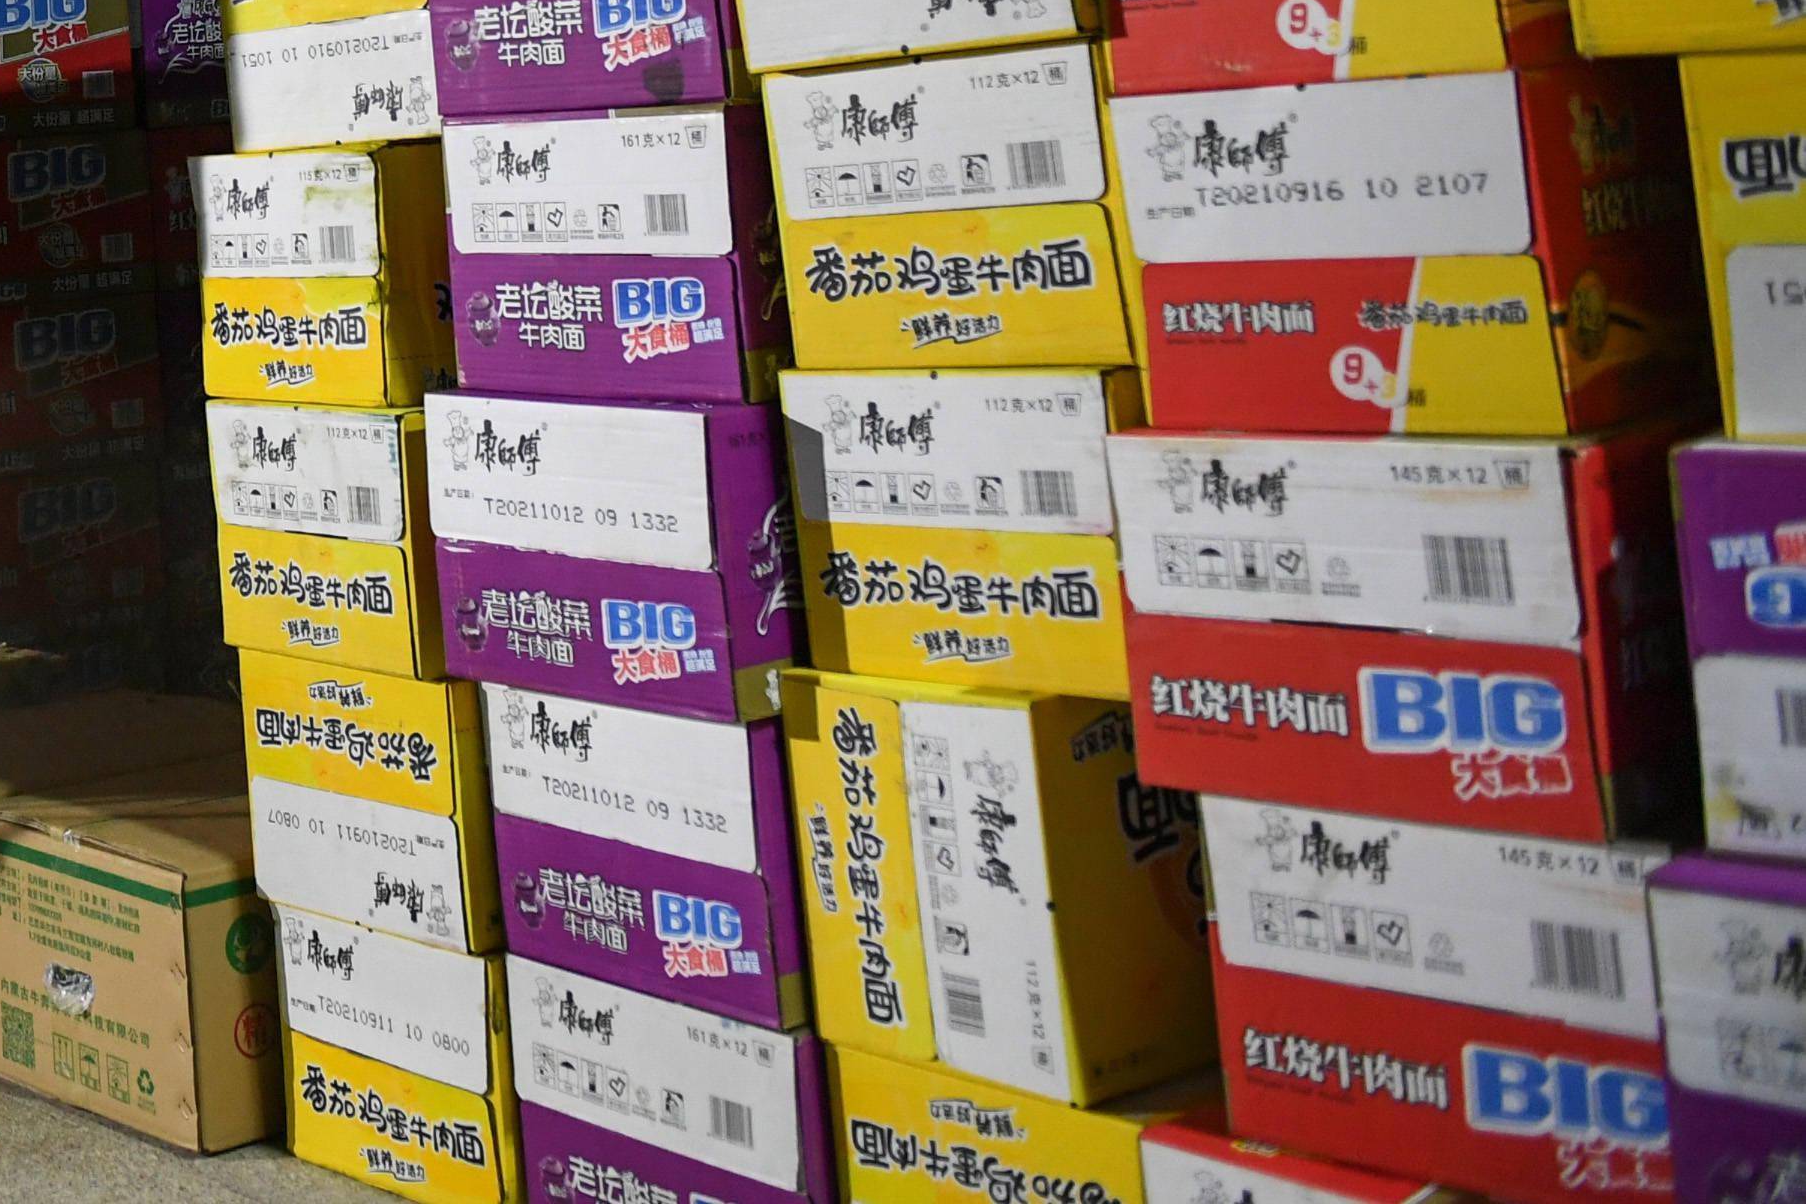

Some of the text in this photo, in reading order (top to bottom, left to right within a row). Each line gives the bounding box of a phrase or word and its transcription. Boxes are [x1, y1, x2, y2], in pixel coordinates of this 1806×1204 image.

[281, 50, 296, 63] 10
[498, 40, 566, 66] 牛肉面
[605, 24, 673, 71] 大食桶
[7, 144, 106, 202] BIG
[1194, 172, 1489, 208] T20210916 10 2107
[804, 236, 1093, 303] 番茄鸡蛋牛肉面
[210, 302, 367, 348] 番茄鸡蛋牛肉面
[495, 280, 604, 323] 老坛酸菜
[612, 276, 705, 329] BIG
[1161, 299, 1316, 335] 红烧牛肉面
[519, 321, 586, 351] 牛肉面
[623, 323, 691, 364] 大食桶
[483, 497, 679, 533] T20211012 09 1332
[229, 552, 393, 616] 番茄鸡蛋牛肉面
[819, 550, 1100, 619] 番茄鸡蛋牛肉面
[481, 588, 594, 642] 老坛酸菜
[601, 598, 696, 650] BIG
[506, 630, 575, 668] 牛肉面
[613, 649, 680, 685] 大食桶
[1150, 674, 1350, 739] 红烧牛肉面
[1358, 665, 1567, 755] BIG
[255, 708, 437, 782] 番茄鸡蛋牛肉面
[541, 774, 728, 834] T20211012 09 1332
[267, 808, 417, 856] T20210911 10 0807
[832, 706, 903, 1028] 番茄鸡蛋牛肉面
[538, 867, 645, 932] 老坛酸菜
[652, 889, 743, 949] BIG
[563, 911, 629, 954] 牛肉面
[663, 942, 728, 978] 大食桶
[318, 995, 470, 1056] T20210911 10 0800
[1243, 1027, 1449, 1110] 红烧牛肉面
[1461, 1040, 1670, 1149] BIG
[301, 1065, 485, 1167] 番茄鸡蛋牛肉面
